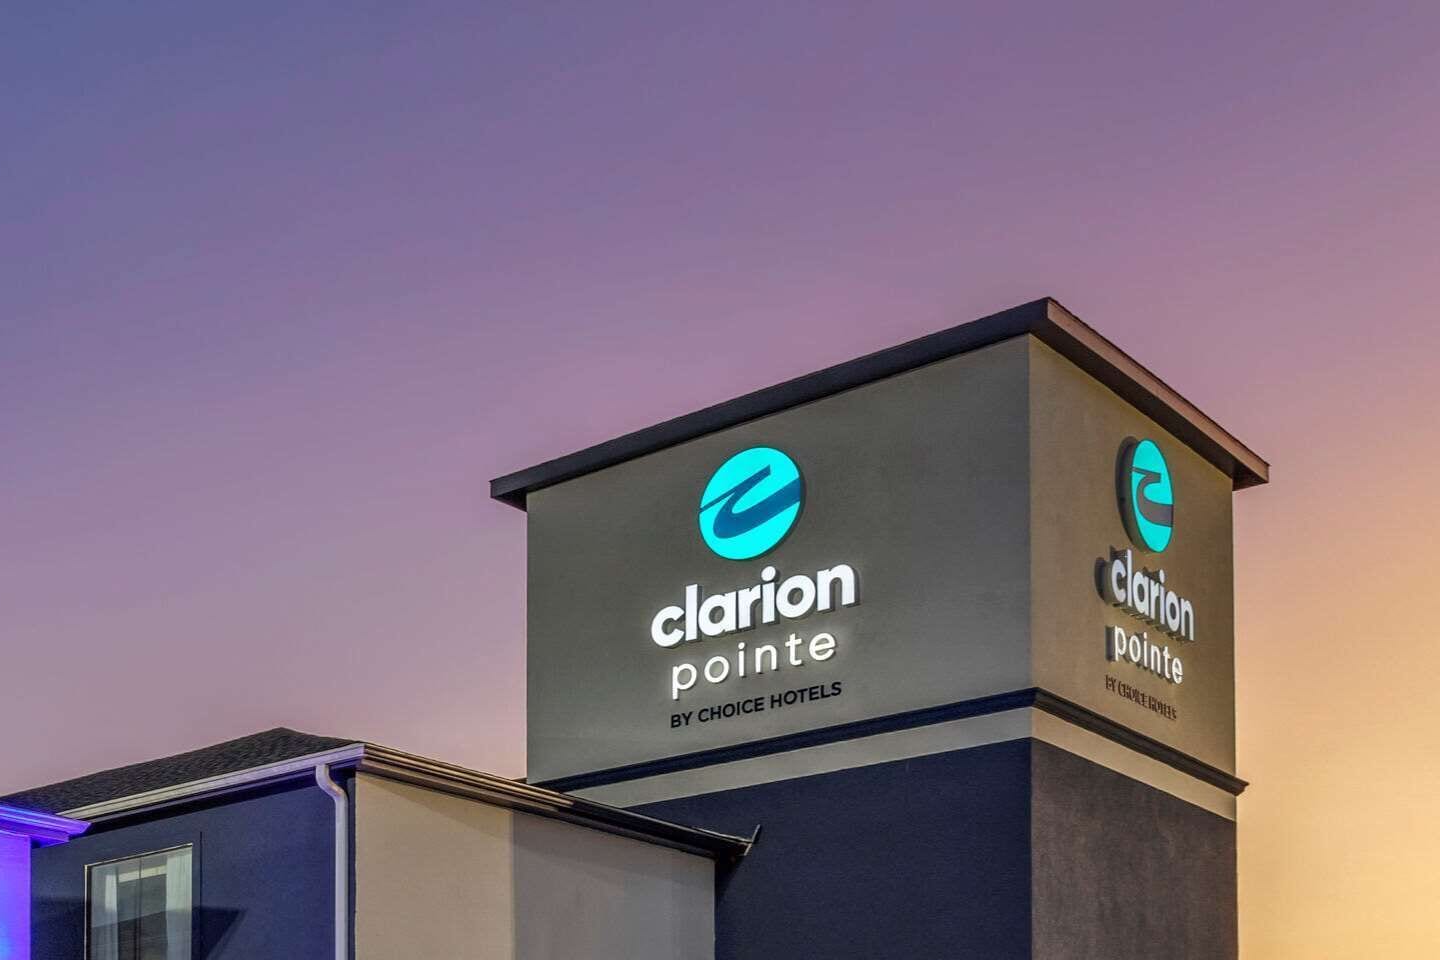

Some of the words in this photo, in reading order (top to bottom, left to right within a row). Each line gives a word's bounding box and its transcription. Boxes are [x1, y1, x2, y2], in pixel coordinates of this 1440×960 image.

[651, 564, 856, 648] clarion
[1111, 549, 1195, 641] clarion
[672, 632, 837, 700] pointe
[1114, 625, 1184, 685] pointe
[670, 711, 693, 728] BY
[698, 697, 765, 722] CHOICE
[770, 681, 843, 709] HOTELS
